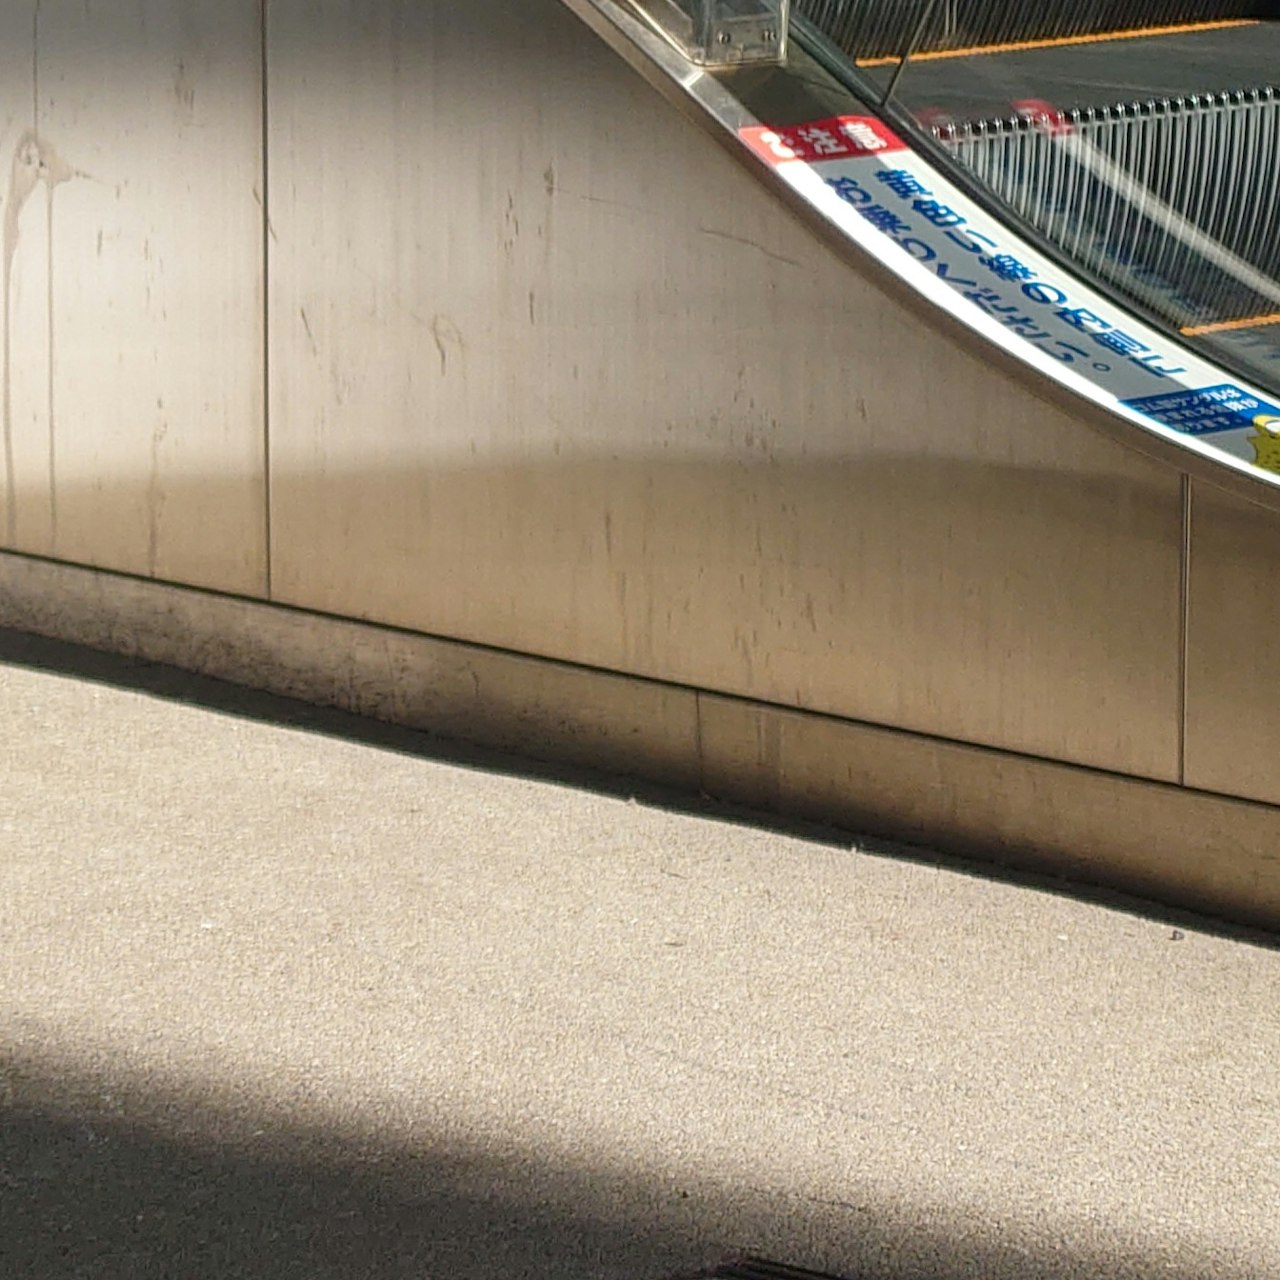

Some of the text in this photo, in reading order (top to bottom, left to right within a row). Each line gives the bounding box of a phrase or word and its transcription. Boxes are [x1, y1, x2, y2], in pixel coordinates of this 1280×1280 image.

[760, 121, 888, 158] ご注意
[825, 177, 1111, 372] お乗りください。
[876, 169, 1187, 378] 黄色い線の内側に
